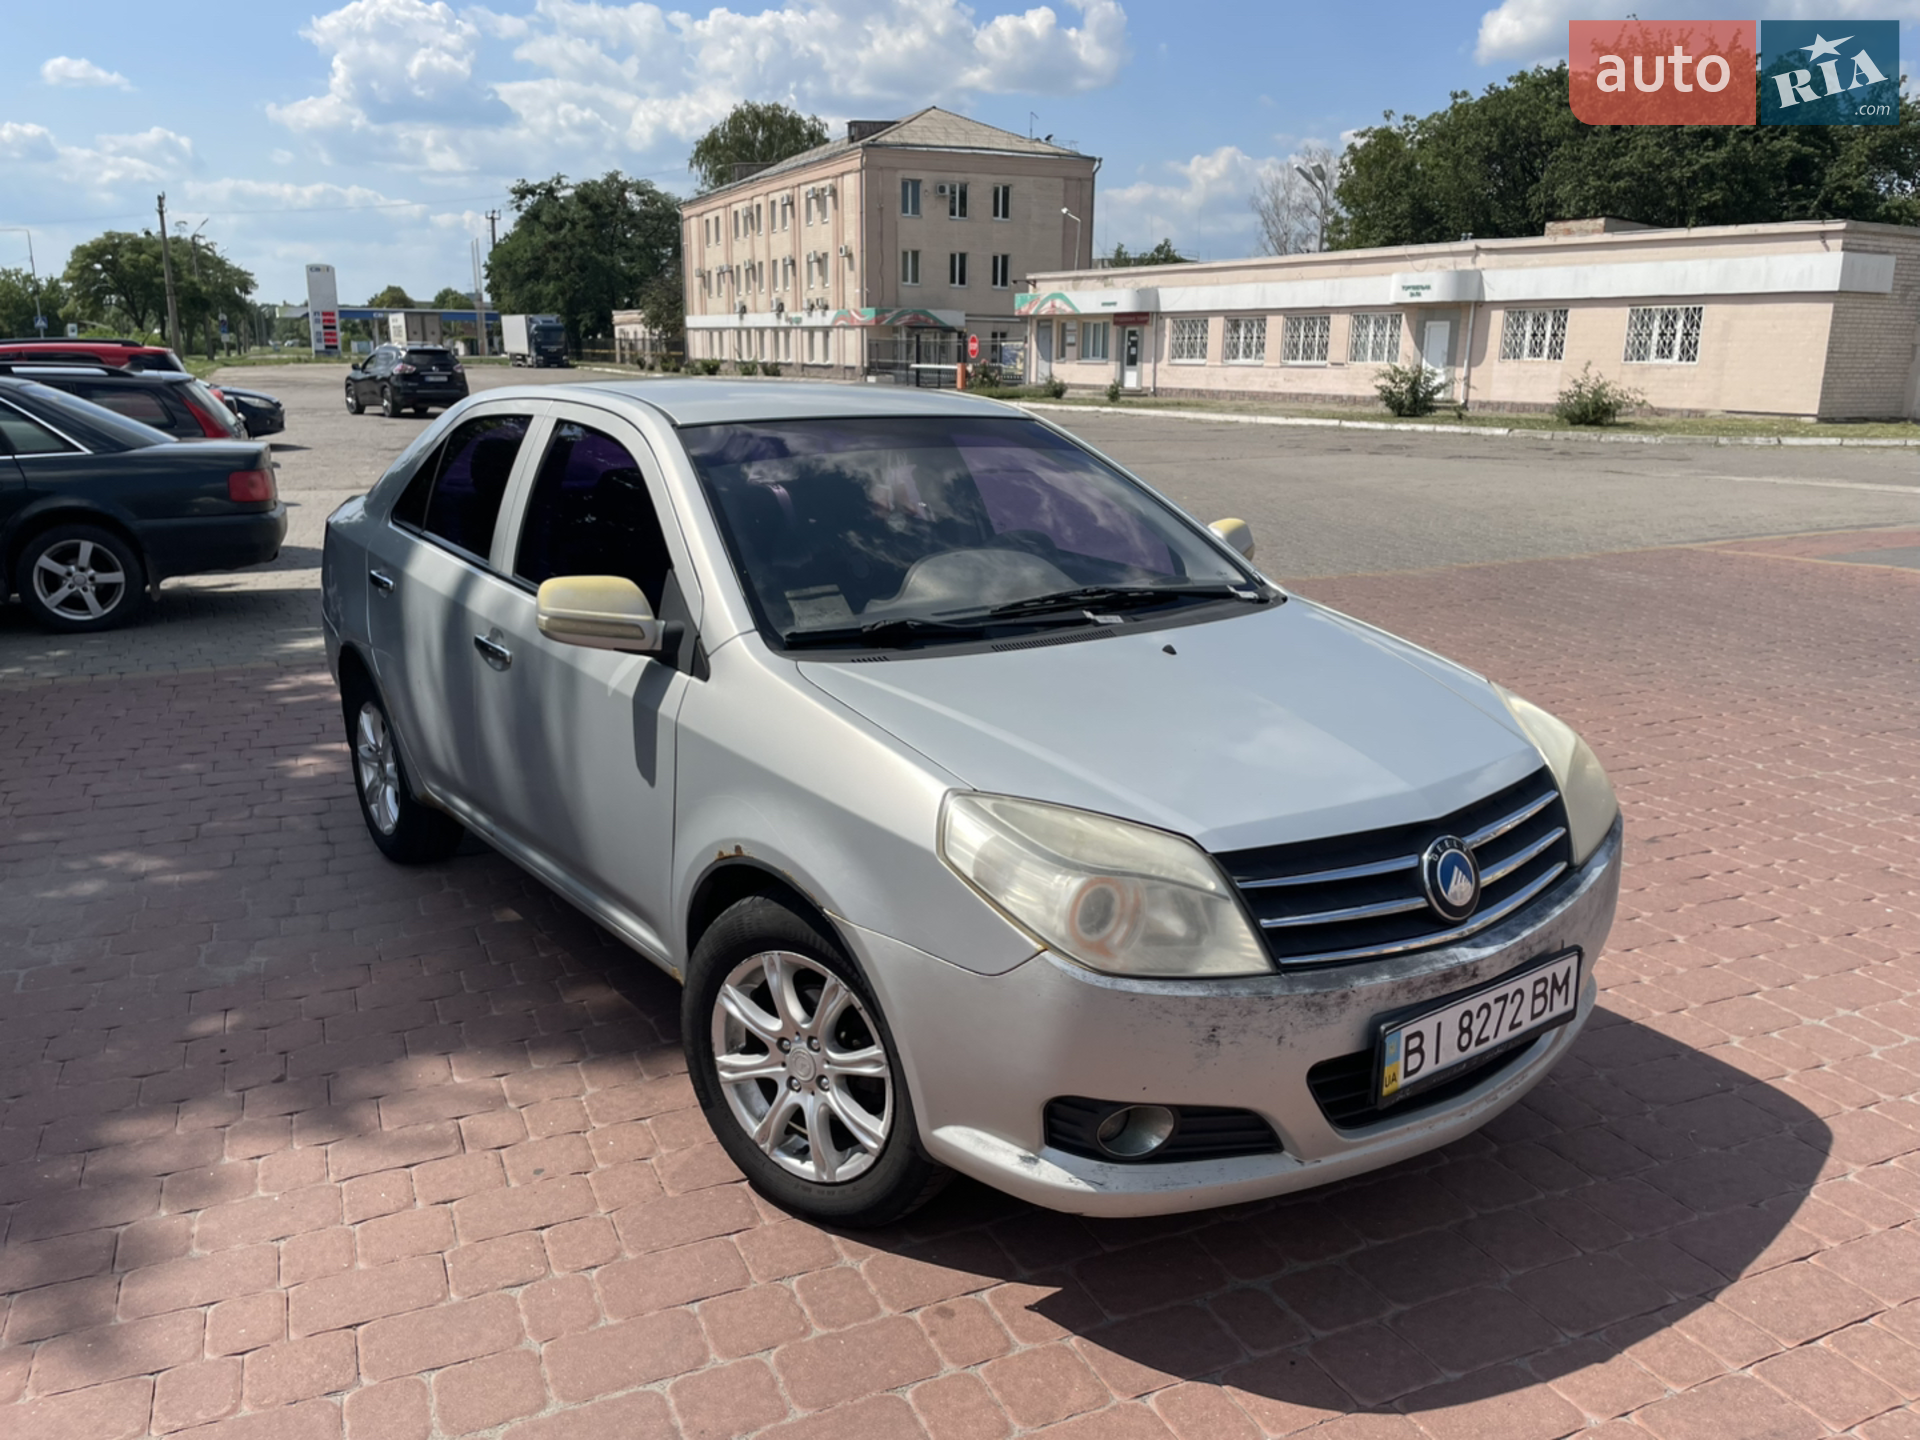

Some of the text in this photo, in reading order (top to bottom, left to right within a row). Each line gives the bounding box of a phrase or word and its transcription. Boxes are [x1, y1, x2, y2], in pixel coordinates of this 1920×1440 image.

[1457, 988, 1525, 1053] 8272
[1531, 965, 1571, 1022] BM
[1384, 1070, 1397, 1089] UA
